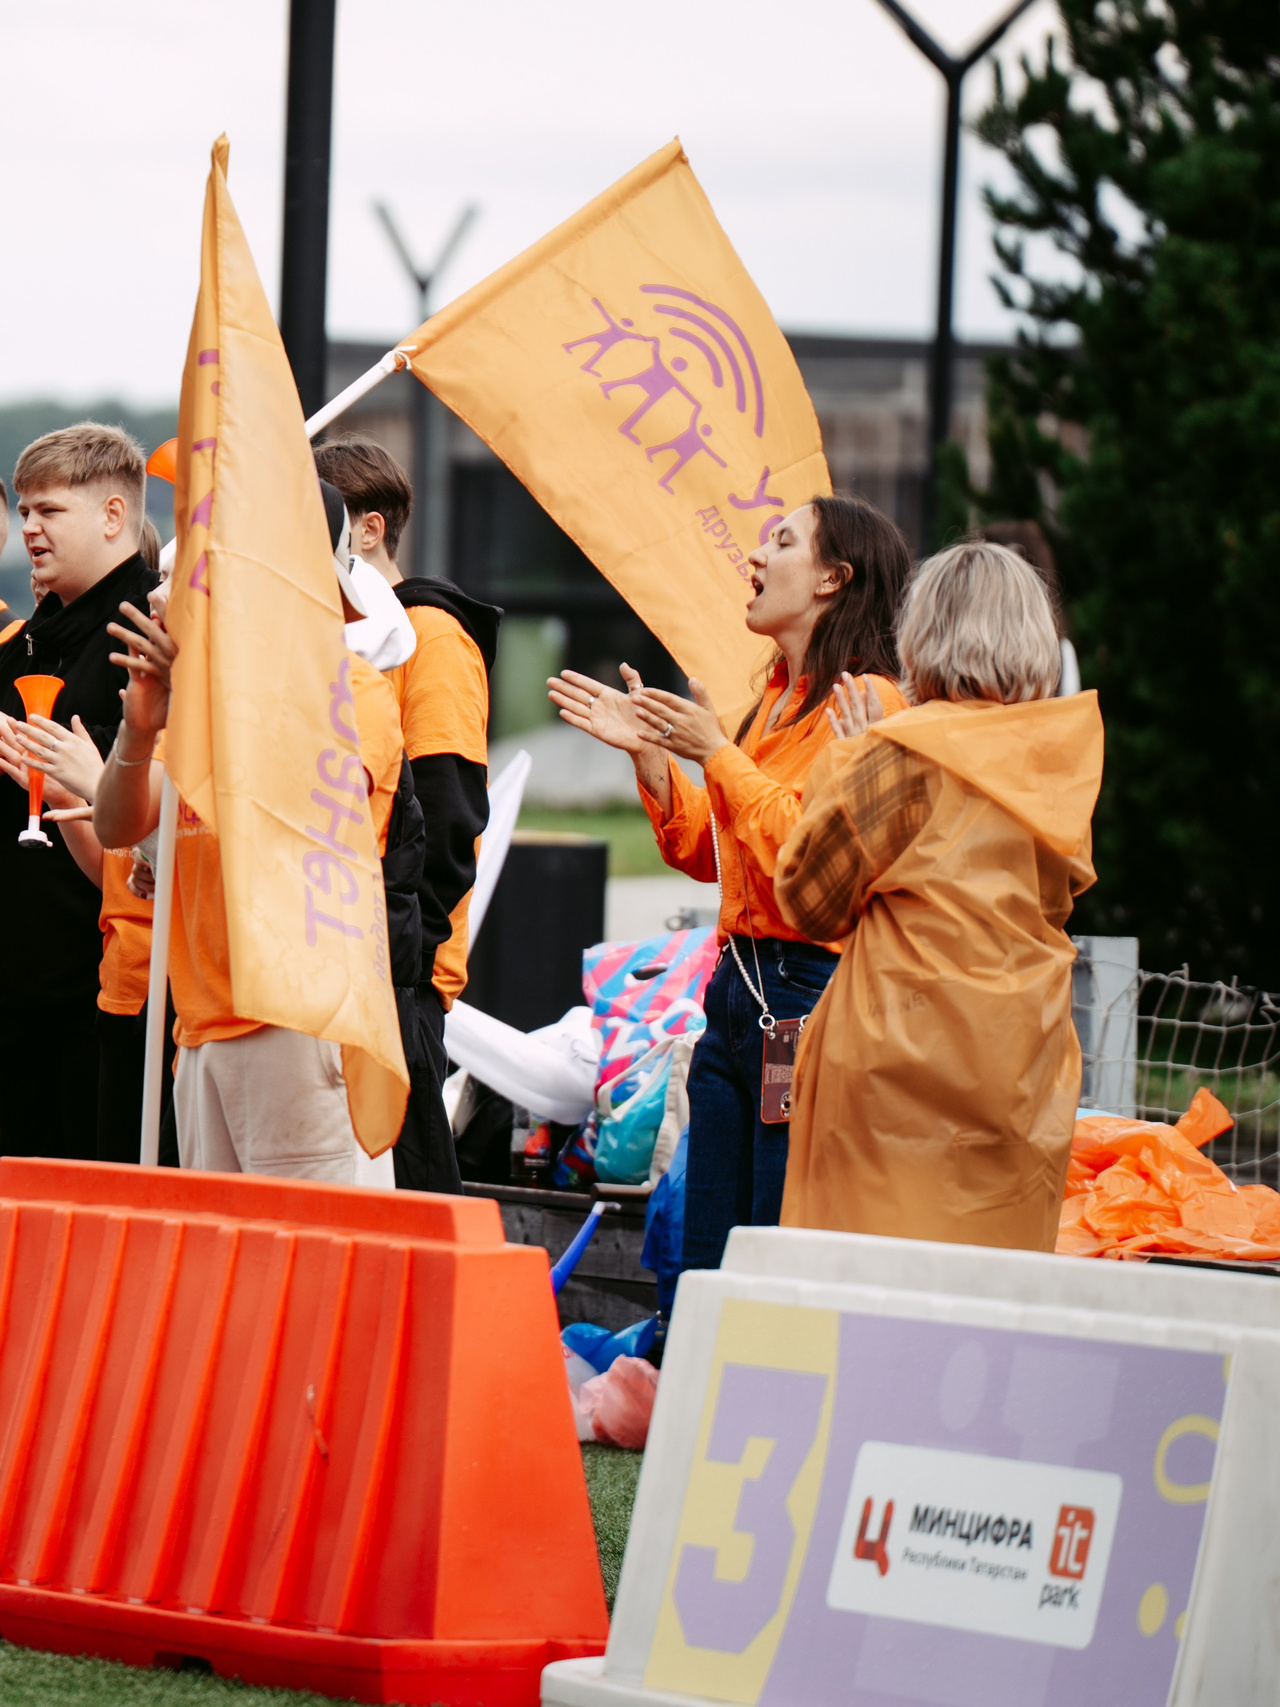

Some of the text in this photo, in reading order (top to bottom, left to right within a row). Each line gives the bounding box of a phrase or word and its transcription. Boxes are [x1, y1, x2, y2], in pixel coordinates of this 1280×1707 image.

[694, 504, 754, 590] друзь
[908, 1503, 1034, 1550] МИНЦИФРА
[901, 1546, 1028, 1581] Республики Татарстан
[1037, 1583, 1081, 1610] park
